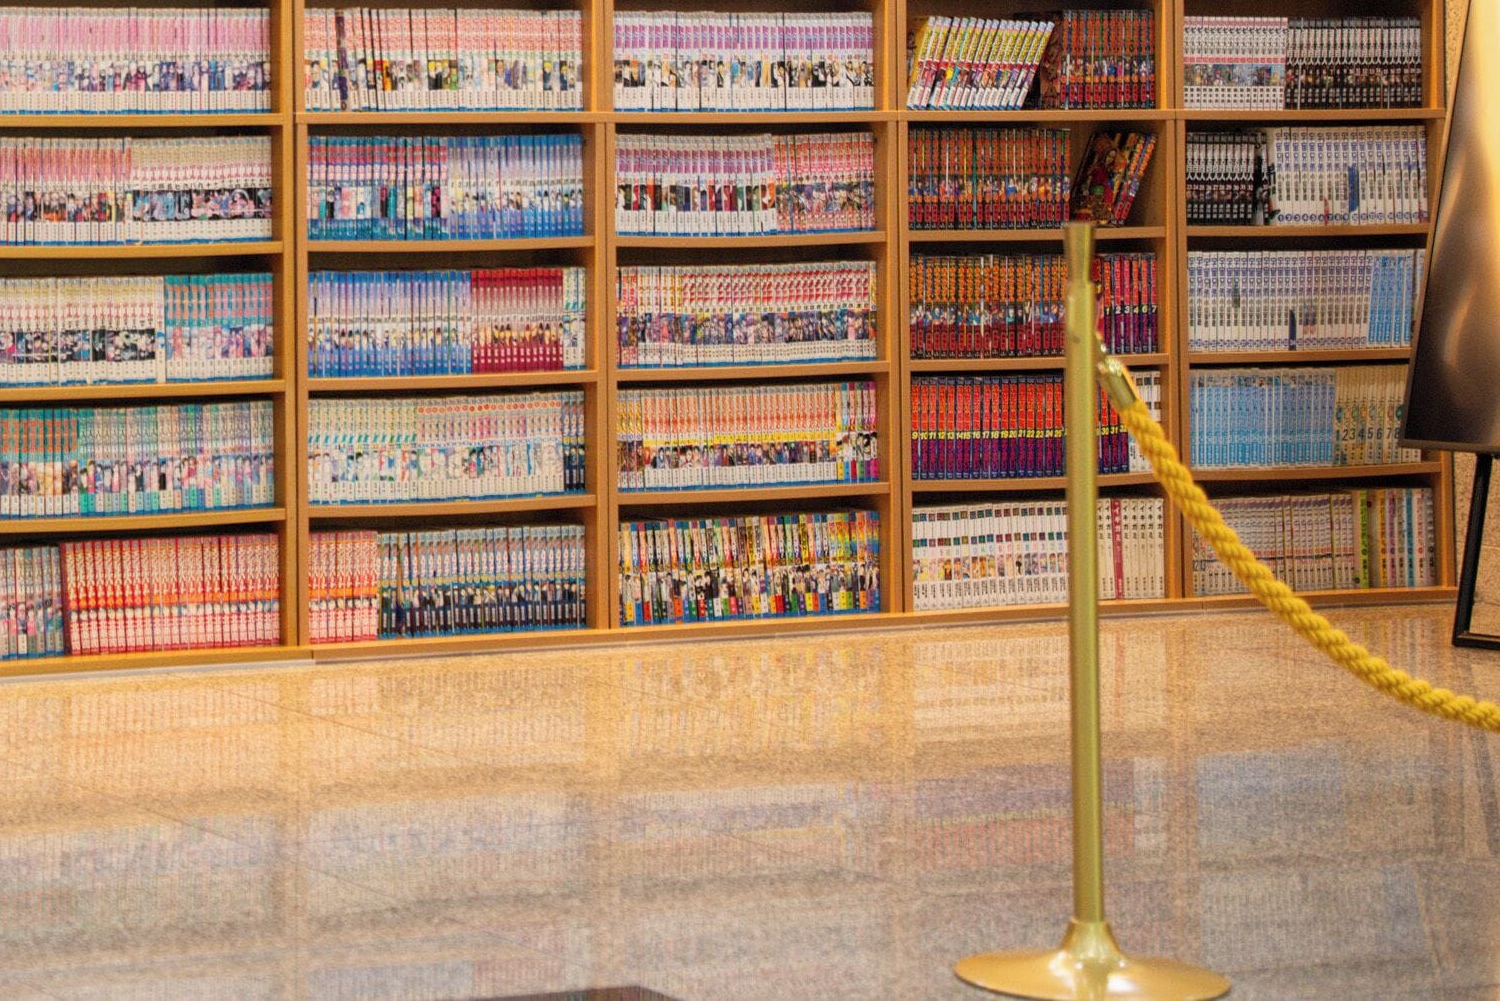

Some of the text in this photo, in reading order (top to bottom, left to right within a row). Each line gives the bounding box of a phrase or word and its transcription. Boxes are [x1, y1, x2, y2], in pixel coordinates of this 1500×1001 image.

[1000, 430, 1008, 438] 19
[1009, 430, 1016, 438] 20
[1027, 430, 1034, 438] 22
[1036, 430, 1044, 438] 23
[1101, 427, 1109, 435] 30
[1110, 426, 1118, 434] 31
[1350, 428, 1356, 439] 3
[1358, 428, 1364, 438] 4
[1368, 427, 1373, 438] 5
[1377, 427, 1382, 438] 6
[1387, 427, 1392, 438] 7
[930, 431, 936, 439] 11
[938, 431, 946, 439] 12
[947, 431, 955, 439] 13
[956, 431, 963, 439] 14
[963, 431, 971, 439] 15
[973, 431, 981, 439] 16
[983, 431, 989, 439] 17
[1336, 429, 1340, 440] 1
[1342, 429, 1348, 441] 2
